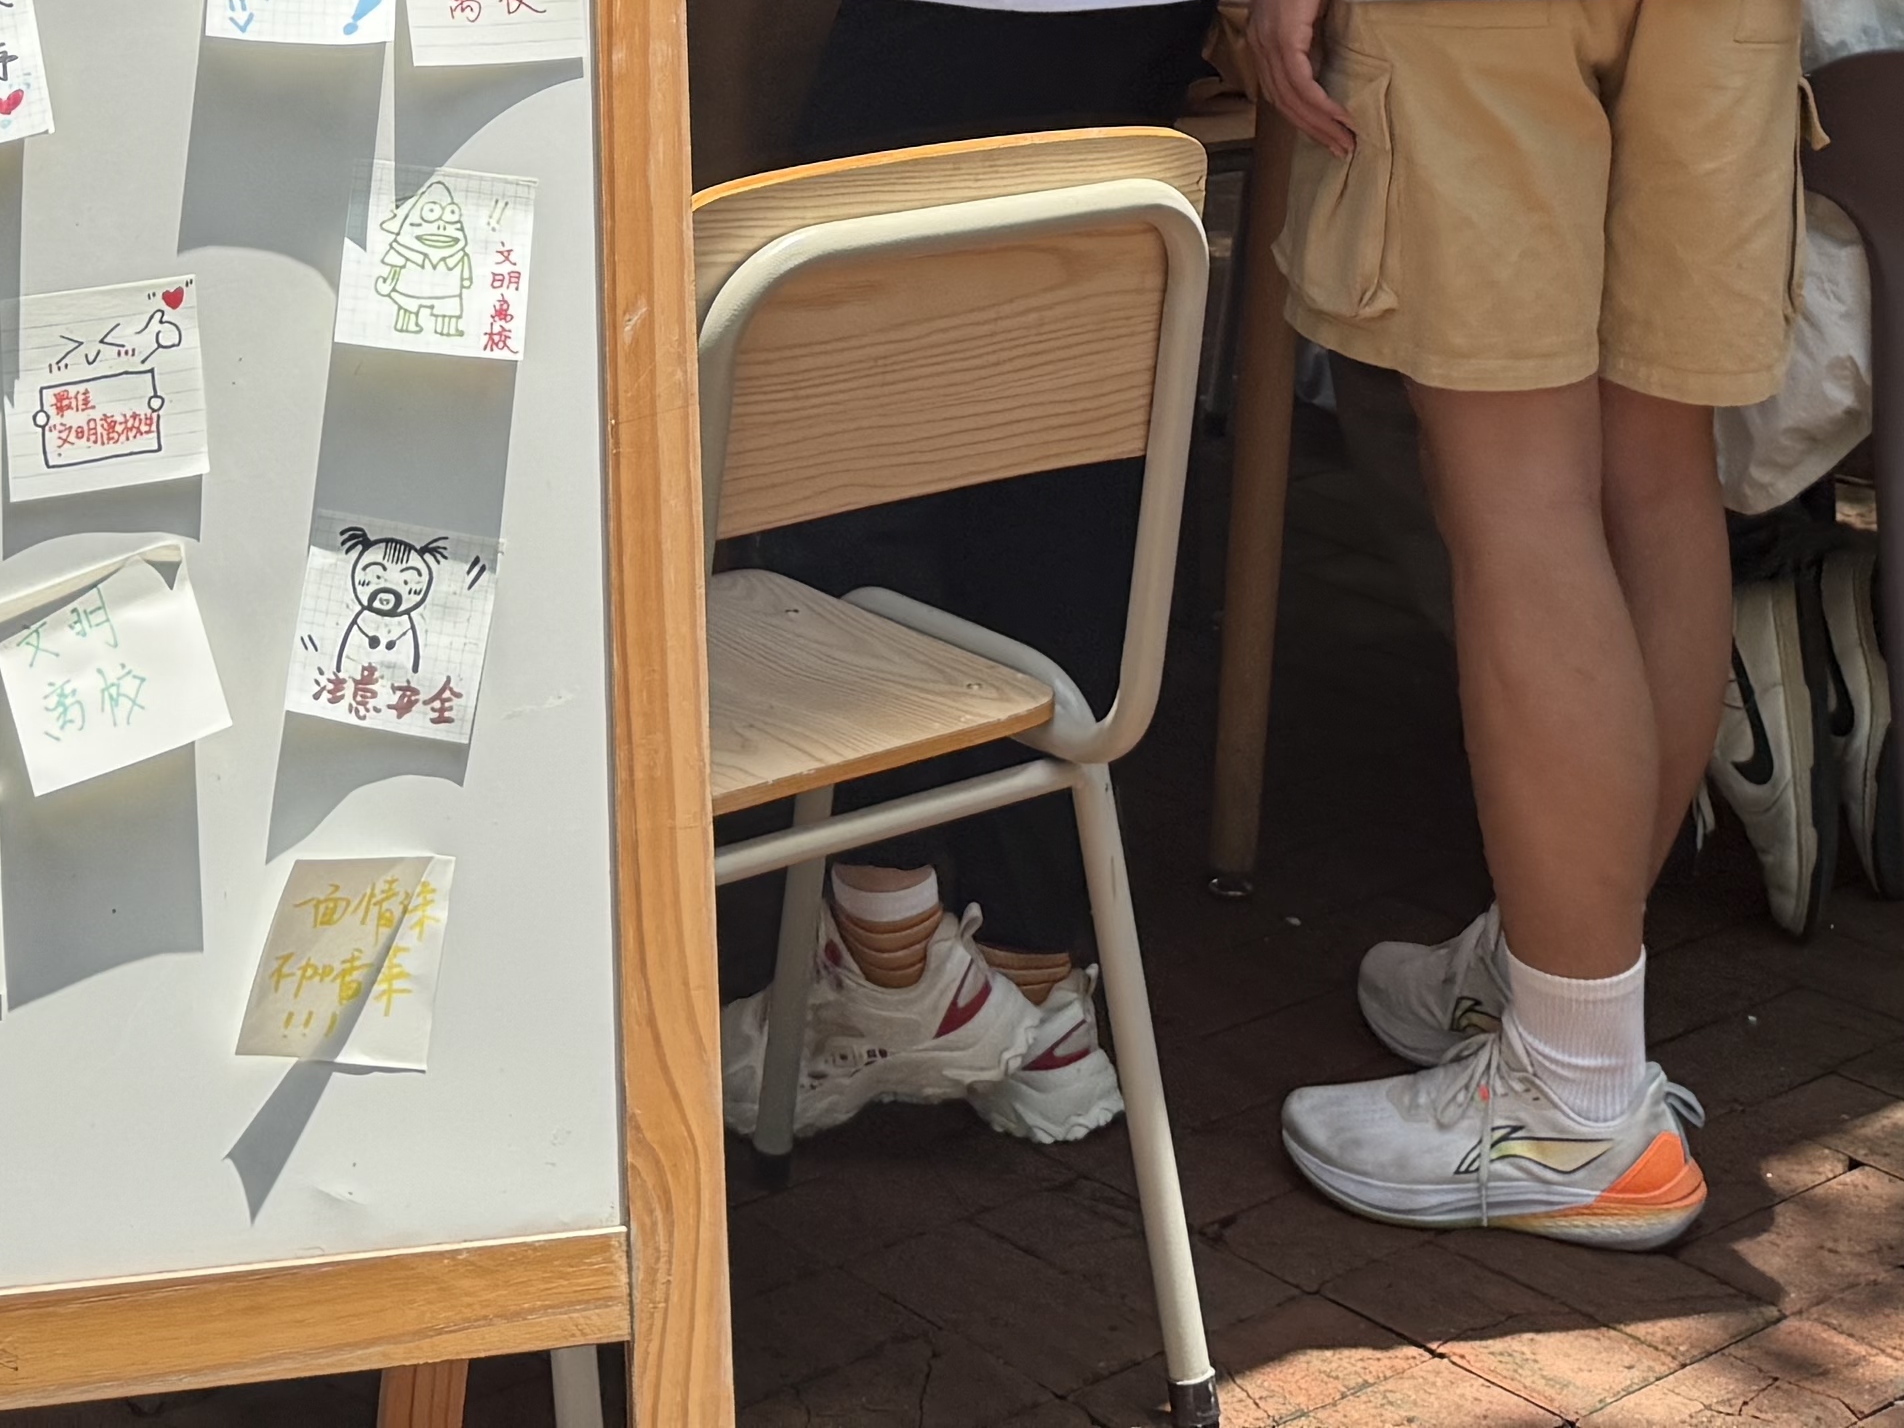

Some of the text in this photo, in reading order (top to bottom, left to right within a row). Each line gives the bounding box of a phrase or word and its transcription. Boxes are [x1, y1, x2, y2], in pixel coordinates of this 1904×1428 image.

[482, 241, 522, 355] 文明离校
[50, 388, 96, 418] 最佳
[312, 661, 464, 725] 注意安全
